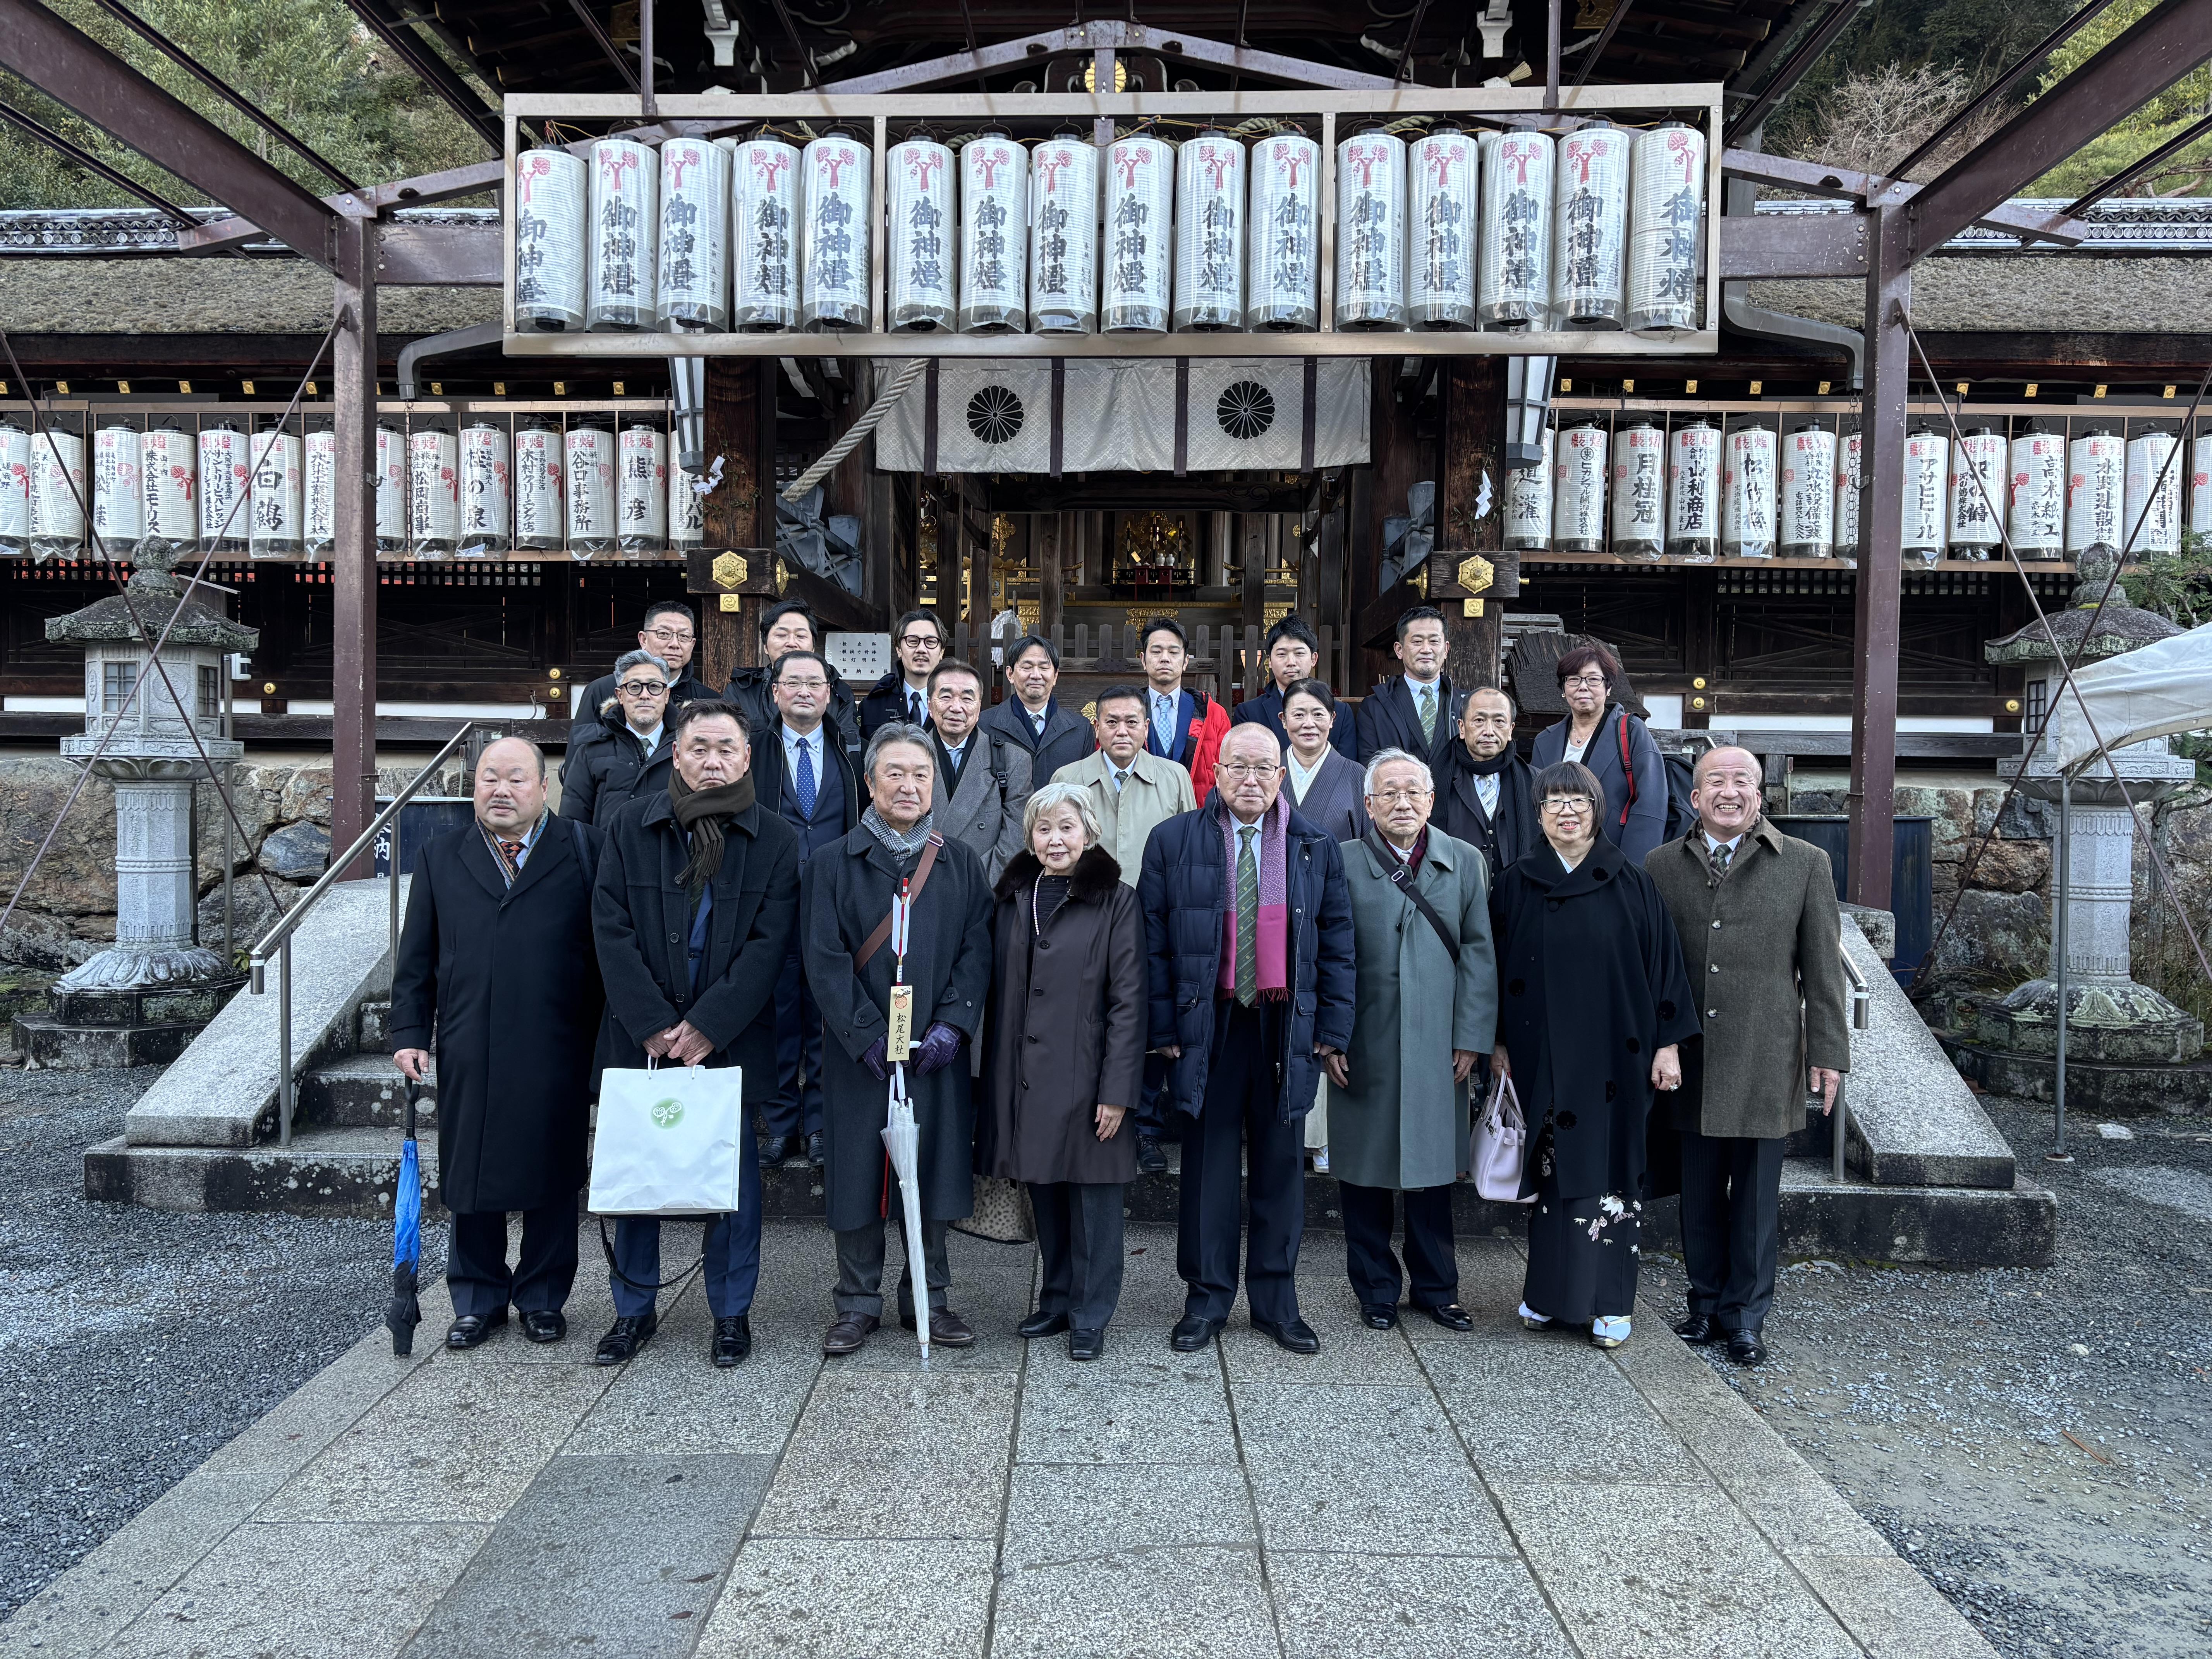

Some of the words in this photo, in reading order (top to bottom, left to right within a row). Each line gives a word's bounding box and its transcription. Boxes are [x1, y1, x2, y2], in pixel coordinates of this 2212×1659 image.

[601, 196, 640, 296] 御神燈
[661, 193, 698, 291] 御神燈
[754, 196, 790, 297] 御神燈
[817, 192, 854, 291] 御神燈
[909, 196, 942, 291] 御神燈
[973, 195, 1008, 291] 御神燈
[1037, 200, 1070, 294] 御神燈
[1113, 193, 1149, 294] 御神燈
[1200, 196, 1235, 294] 御神燈
[1274, 193, 1309, 295] 御神燈
[1349, 190, 1387, 292] 御神燈
[1423, 191, 1462, 292] 御神燈
[1500, 189, 1540, 290] 御神燈
[1563, 187, 1607, 288] 御神燈
[203, 450, 213, 529] ソリューション株式会社
[213, 449, 226, 529] サントリービバレッジ
[415, 471, 433, 534] 松岡商事
[521, 448, 538, 532] 木村クリーニング店
[572, 451, 592, 531] 谷口事務所
[626, 455, 647, 520] 熊彦
[1578, 461, 1591, 535] ヒガシマル醤油株式会社
[1631, 453, 1657, 524] 月桂冠
[1685, 460, 1706, 530] 山利商店
[1916, 458, 1938, 539] アサヒビール
[894, 1013, 907, 1055] 松尾大社
